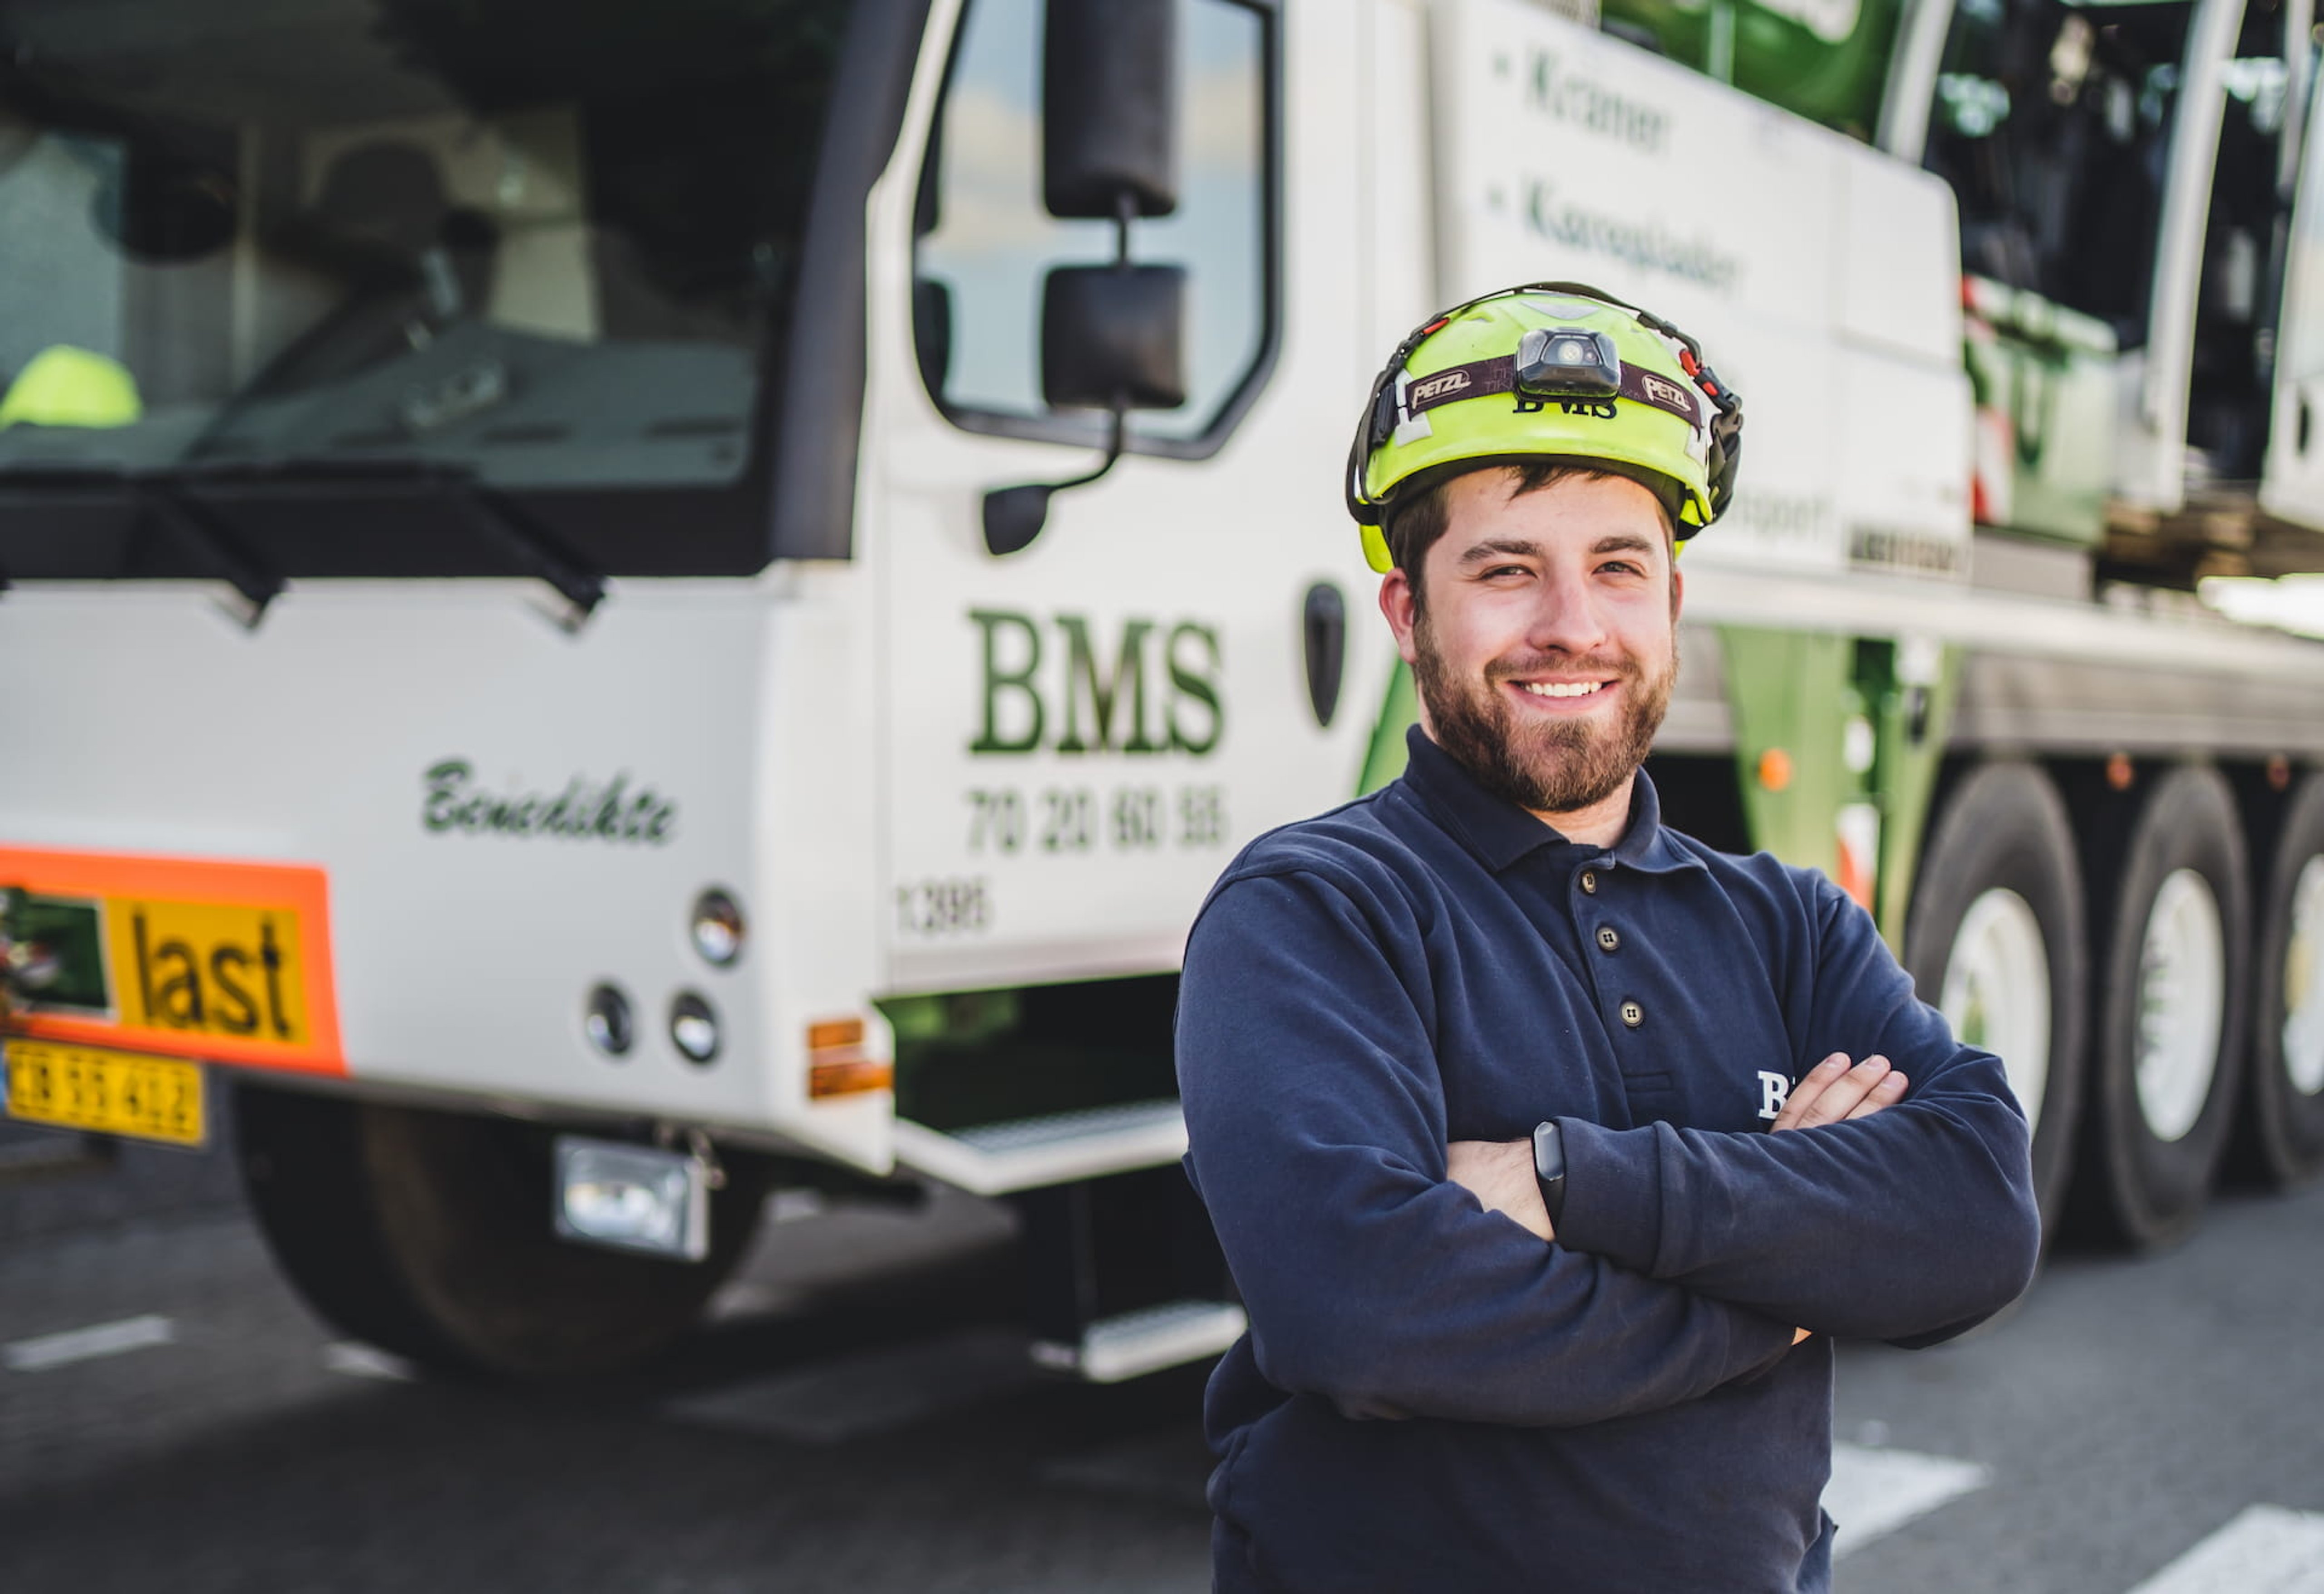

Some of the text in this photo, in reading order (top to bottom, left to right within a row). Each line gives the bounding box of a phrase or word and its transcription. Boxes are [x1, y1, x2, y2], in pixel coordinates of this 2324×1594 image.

[1412, 373, 1472, 409] PETZL
[1644, 377, 1692, 411] PETZL
[968, 608, 1226, 755] BMS
[423, 760, 676, 844] Benedikte
[965, 783, 1227, 853] 70 20 60 55
[132, 908, 291, 1040] last
